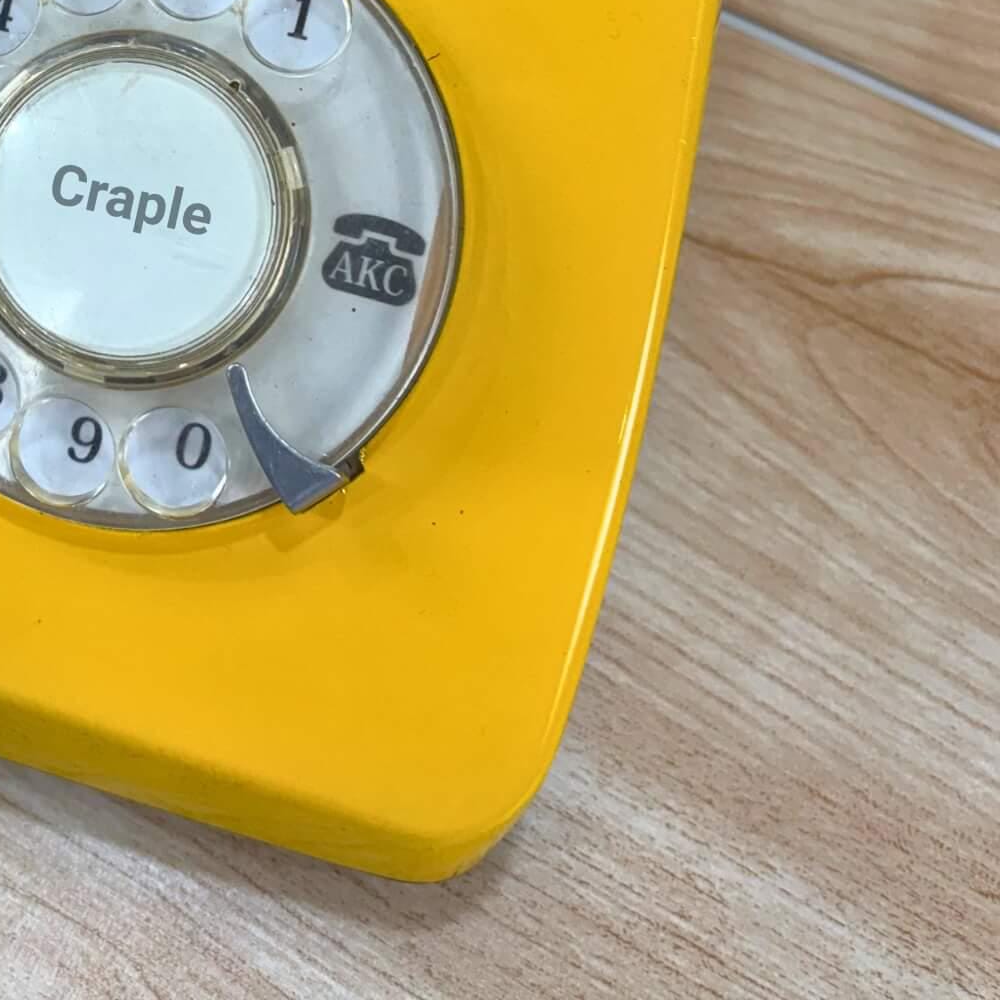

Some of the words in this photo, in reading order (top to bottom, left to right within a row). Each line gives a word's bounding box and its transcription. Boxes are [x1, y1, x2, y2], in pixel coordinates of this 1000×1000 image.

[52, 165, 211, 235] Craple
[328, 250, 408, 297] AKC
[67, 416, 102, 463] 9
[176, 423, 211, 469] 0
